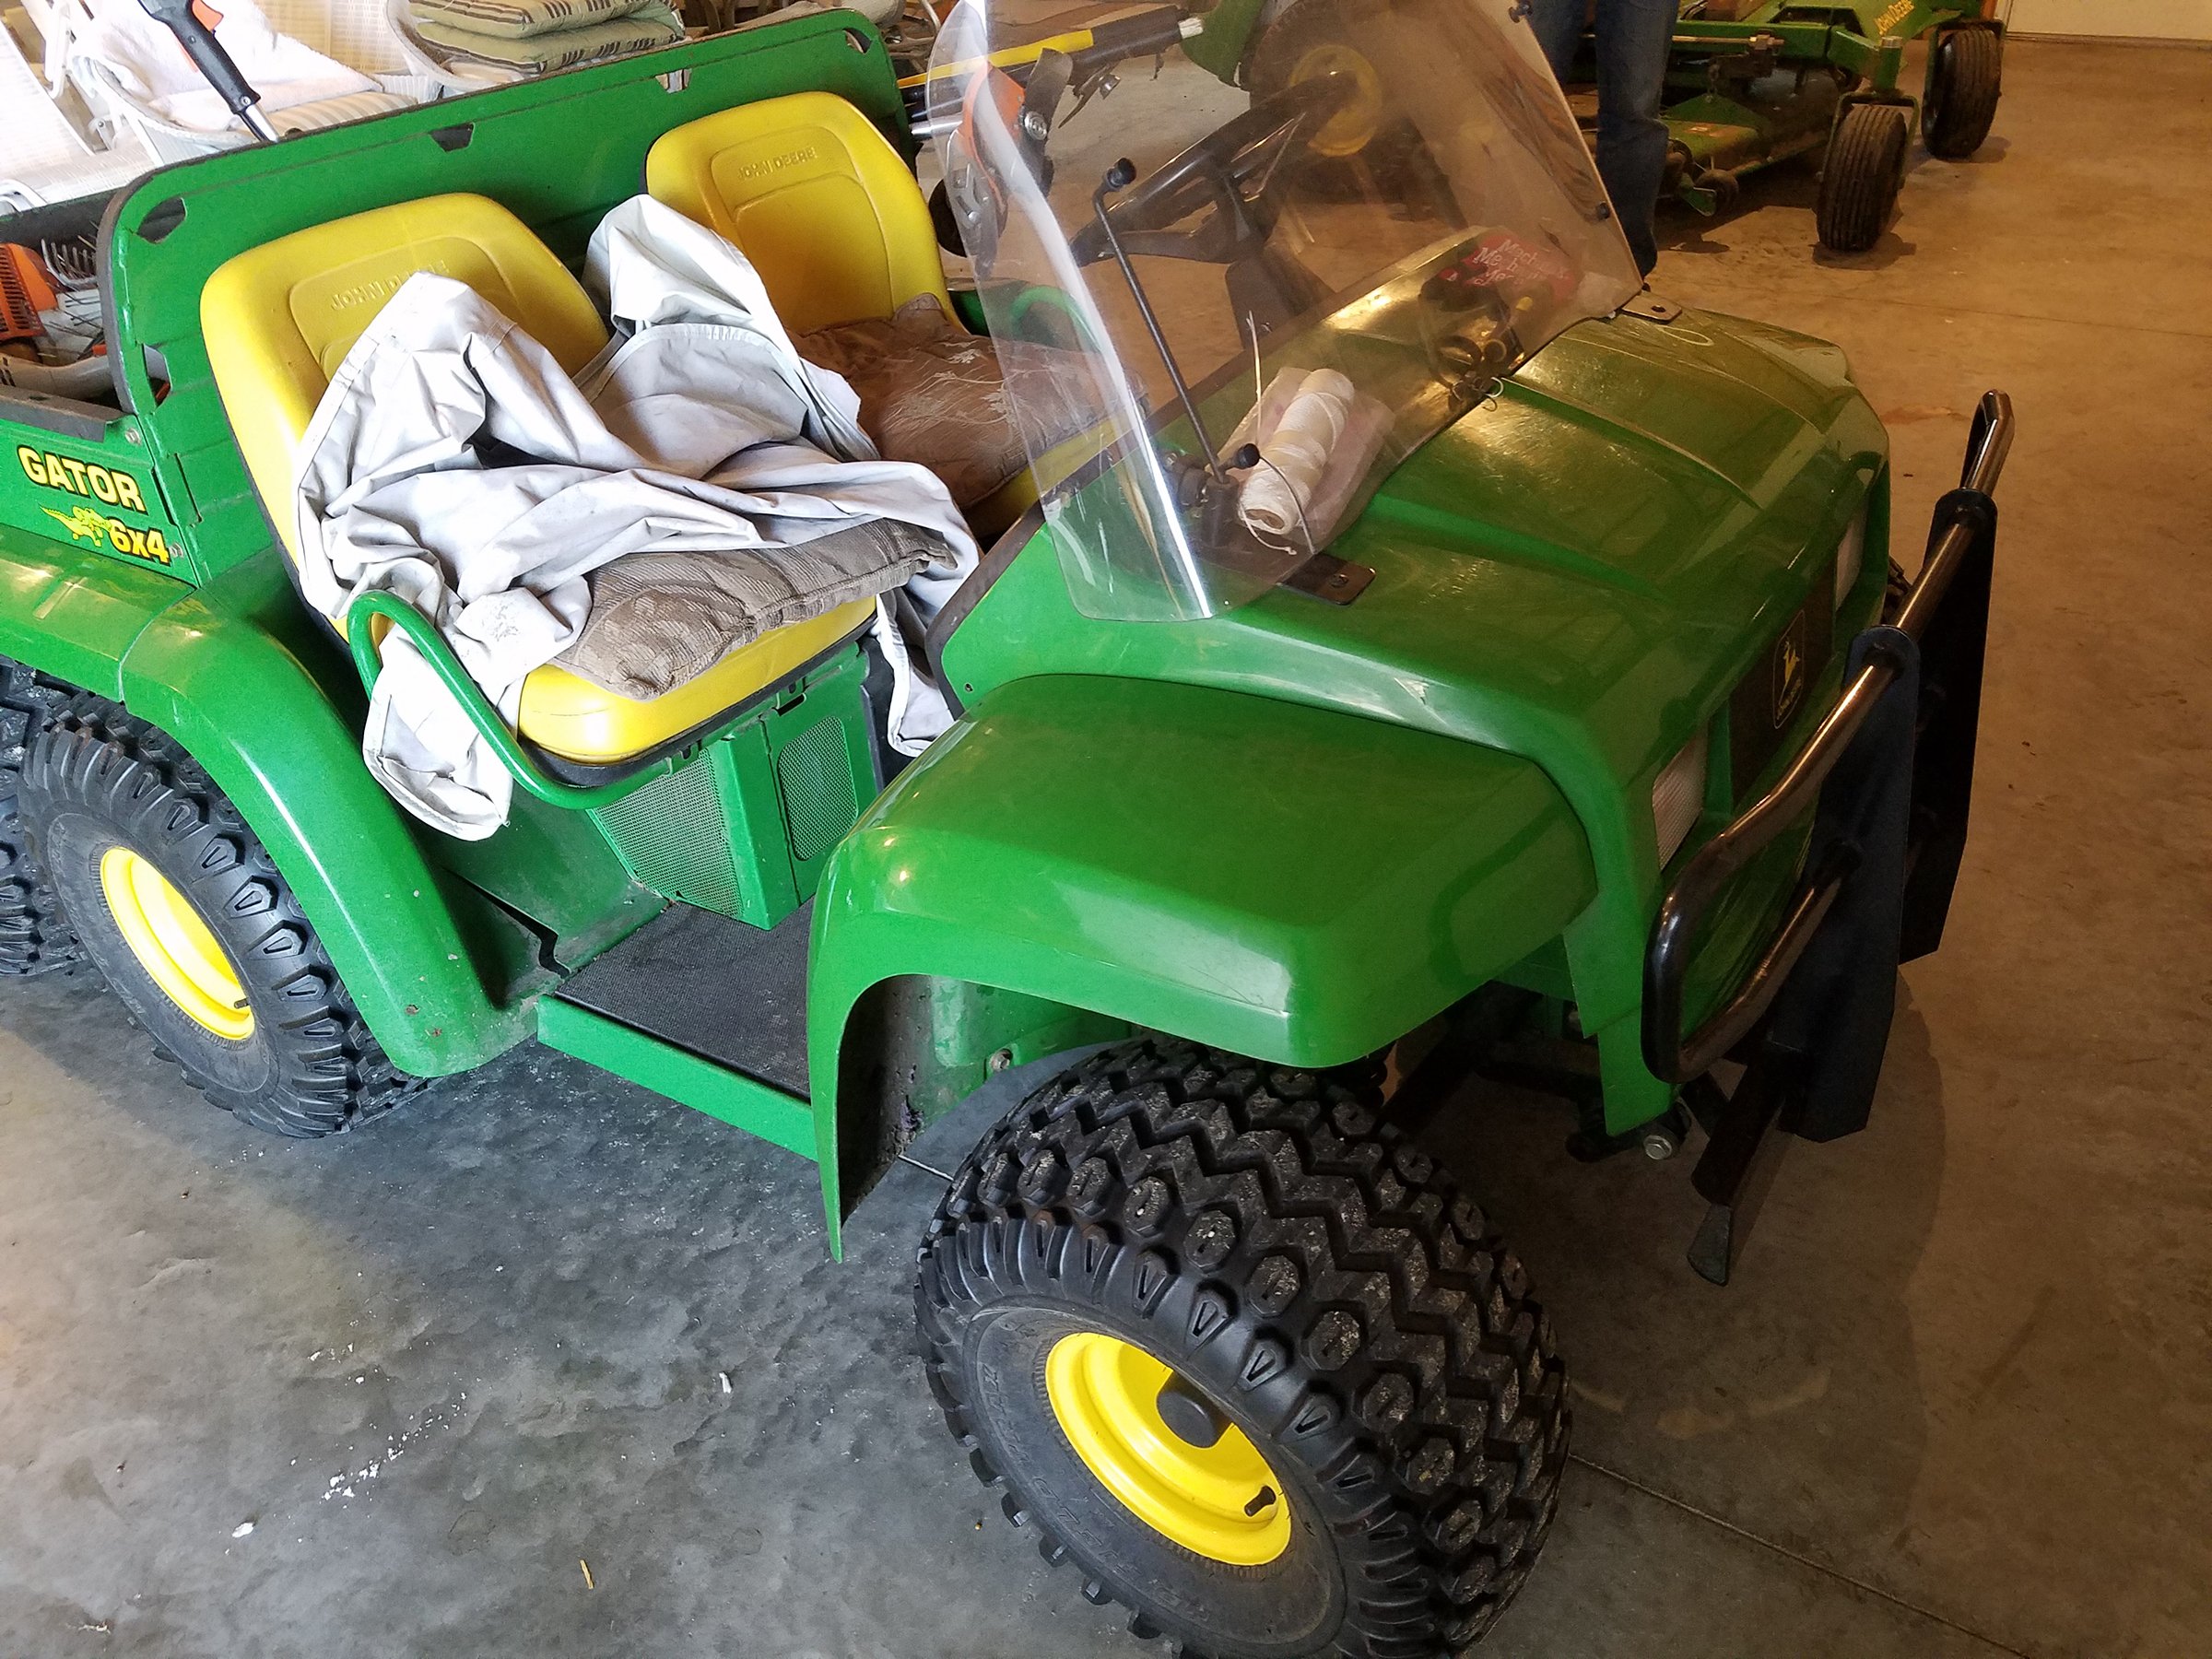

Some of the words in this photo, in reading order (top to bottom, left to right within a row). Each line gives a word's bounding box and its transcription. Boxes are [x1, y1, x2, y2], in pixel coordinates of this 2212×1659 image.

[1873, 11, 1897, 35] JOHN
[737, 159, 774, 180] JOHN
[773, 146, 818, 171] DEERE
[331, 279, 386, 311] JOHN
[17, 444, 148, 515] GATOR
